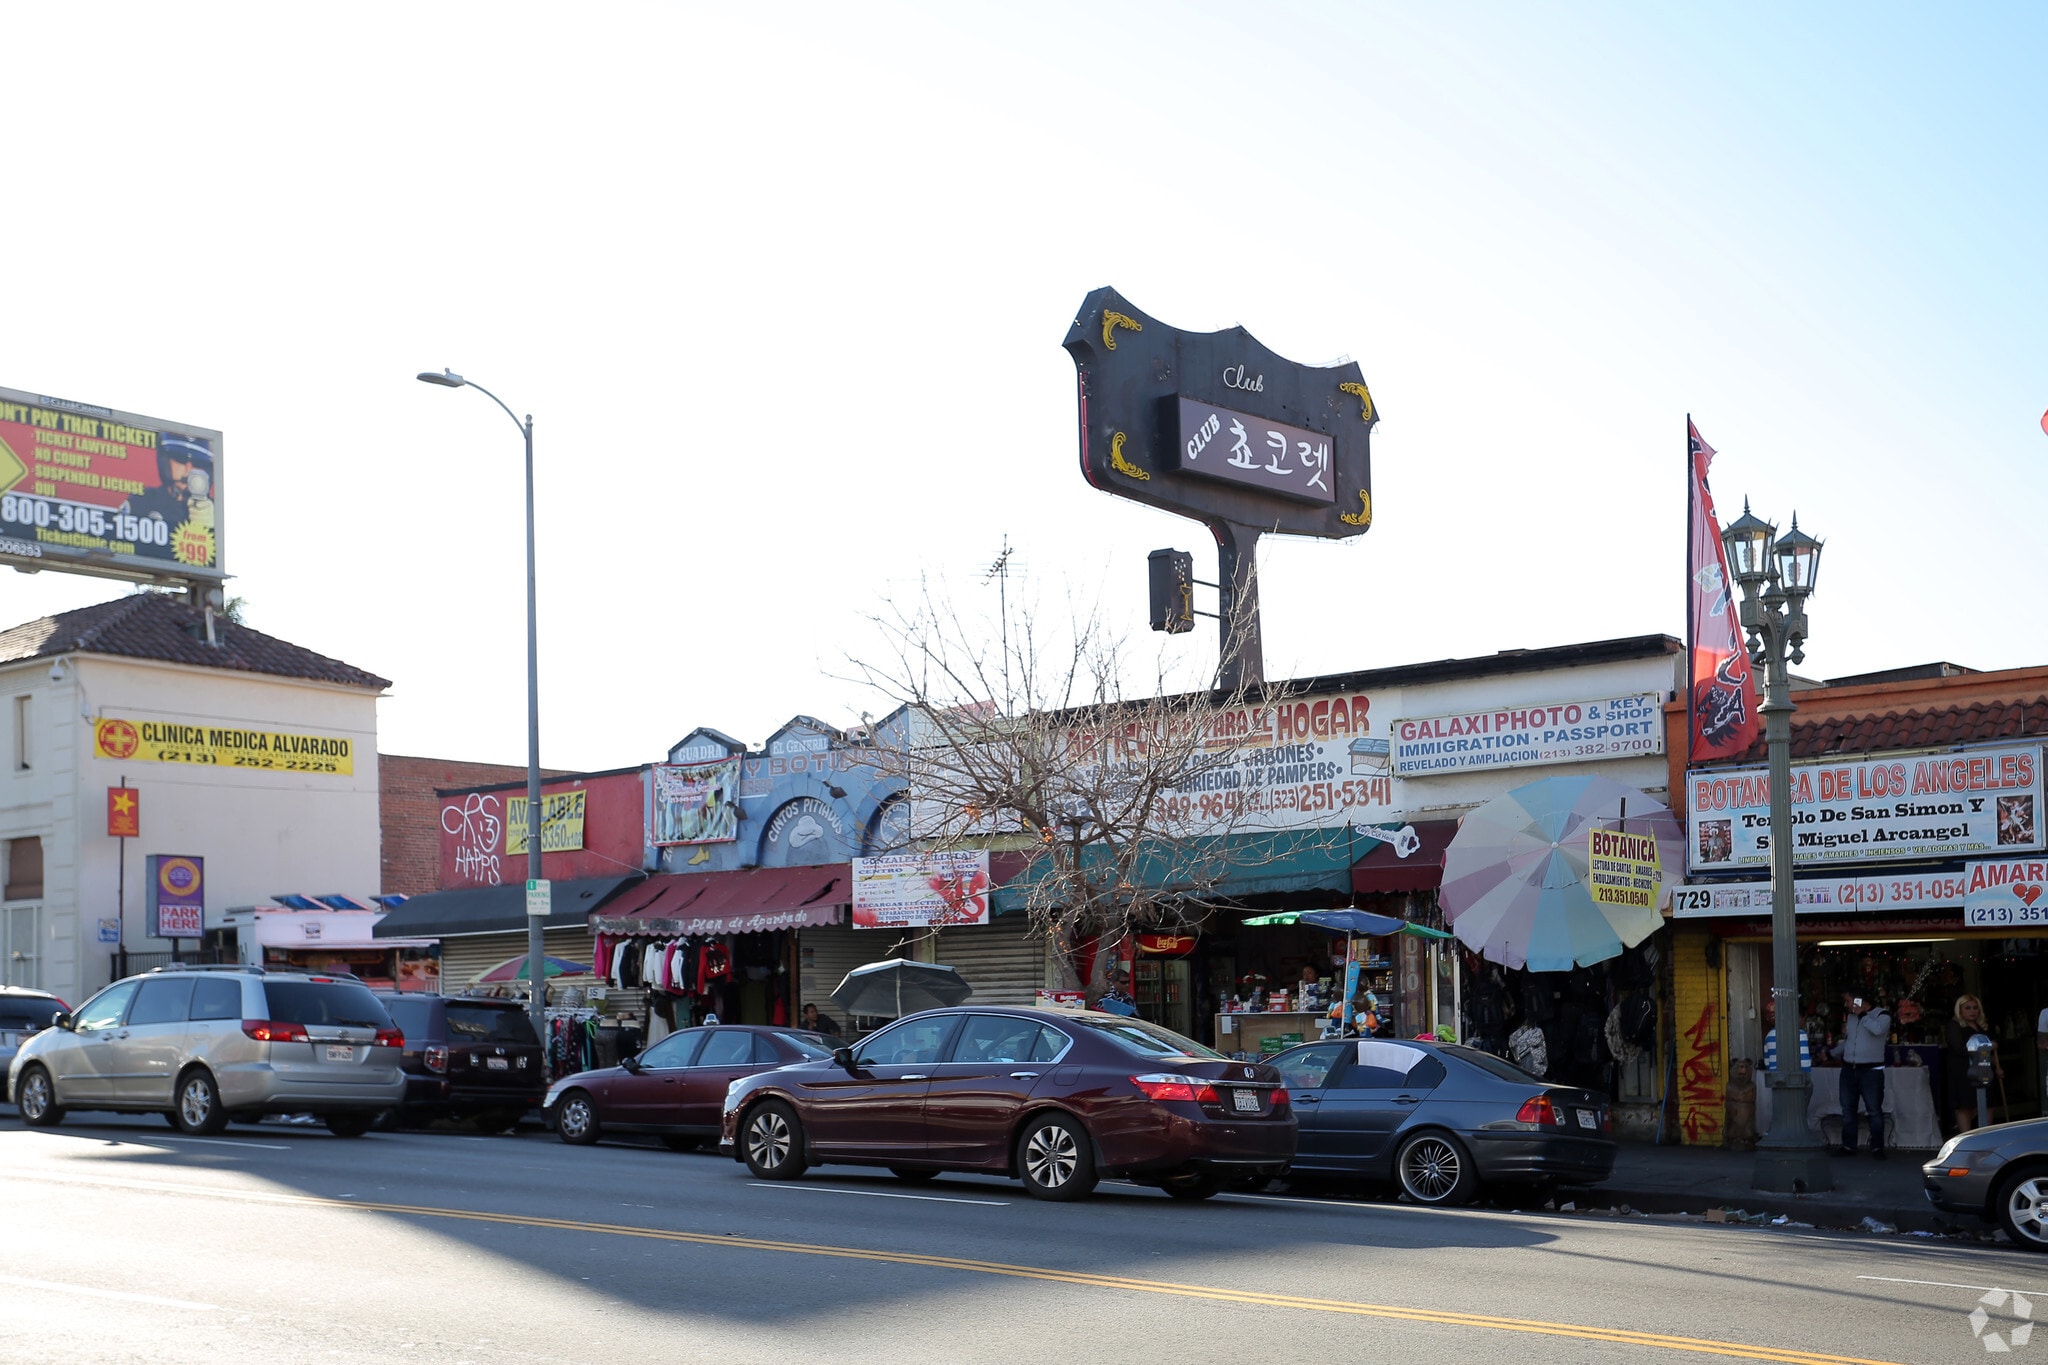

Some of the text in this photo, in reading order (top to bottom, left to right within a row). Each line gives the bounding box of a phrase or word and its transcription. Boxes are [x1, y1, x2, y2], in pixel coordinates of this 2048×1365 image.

[1223, 364, 1264, 392] Club
[31, 407, 59, 430] PAY
[62, 414, 99, 437] THAT
[101, 421, 156, 448] TICKET!
[1187, 413, 1221, 460] CLUB
[35, 430, 127, 459] TICKET LAWYERS
[35, 447, 91, 469] NO COURT
[35, 464, 145, 496] SUSPENDED LICENSE
[35, 483, 55, 497] DUI
[183, 530, 207, 542] from
[179, 541, 207, 563] $99
[1610, 697, 1645, 709] KEY
[1278, 695, 1371, 741] HOGAR
[1400, 704, 1653, 741] GALAXI PHOTO & SHOP
[142, 723, 204, 745] CLINICA
[210, 730, 268, 751] MEDICA
[273, 735, 348, 757] ALVARADO
[773, 738, 829, 755] EL GENERAL
[1399, 721, 1653, 757] IMMIGRATION PASSPORT
[158, 750, 337, 773] (213) 252-2225
[745, 758, 761, 778] Y
[1400, 738, 1653, 772] REVELADO Y AMPLIACION (213) 382-9700
[1267, 761, 1336, 785] PAMPERS
[1696, 752, 2036, 812] BOTANCA DE LOS ANGELES
[768, 800, 799, 843] CINTOS
[1742, 798, 1985, 828] Teplo De San Simon Y
[1593, 832, 1655, 863] BOTANICA
[1798, 829, 1869, 848] Miguel
[1874, 823, 1970, 844] Arcangel
[1823, 849, 1859, 859] AMARRES
[1969, 863, 2048, 894] AMAR
[1599, 887, 1649, 906] 213.351.0540
[1677, 889, 1711, 910] 729
[1838, 882, 1884, 905] (213)
[161, 907, 200, 918] PARK
[161, 918, 200, 930] HERE
[1970, 907, 2013, 924] (213)
